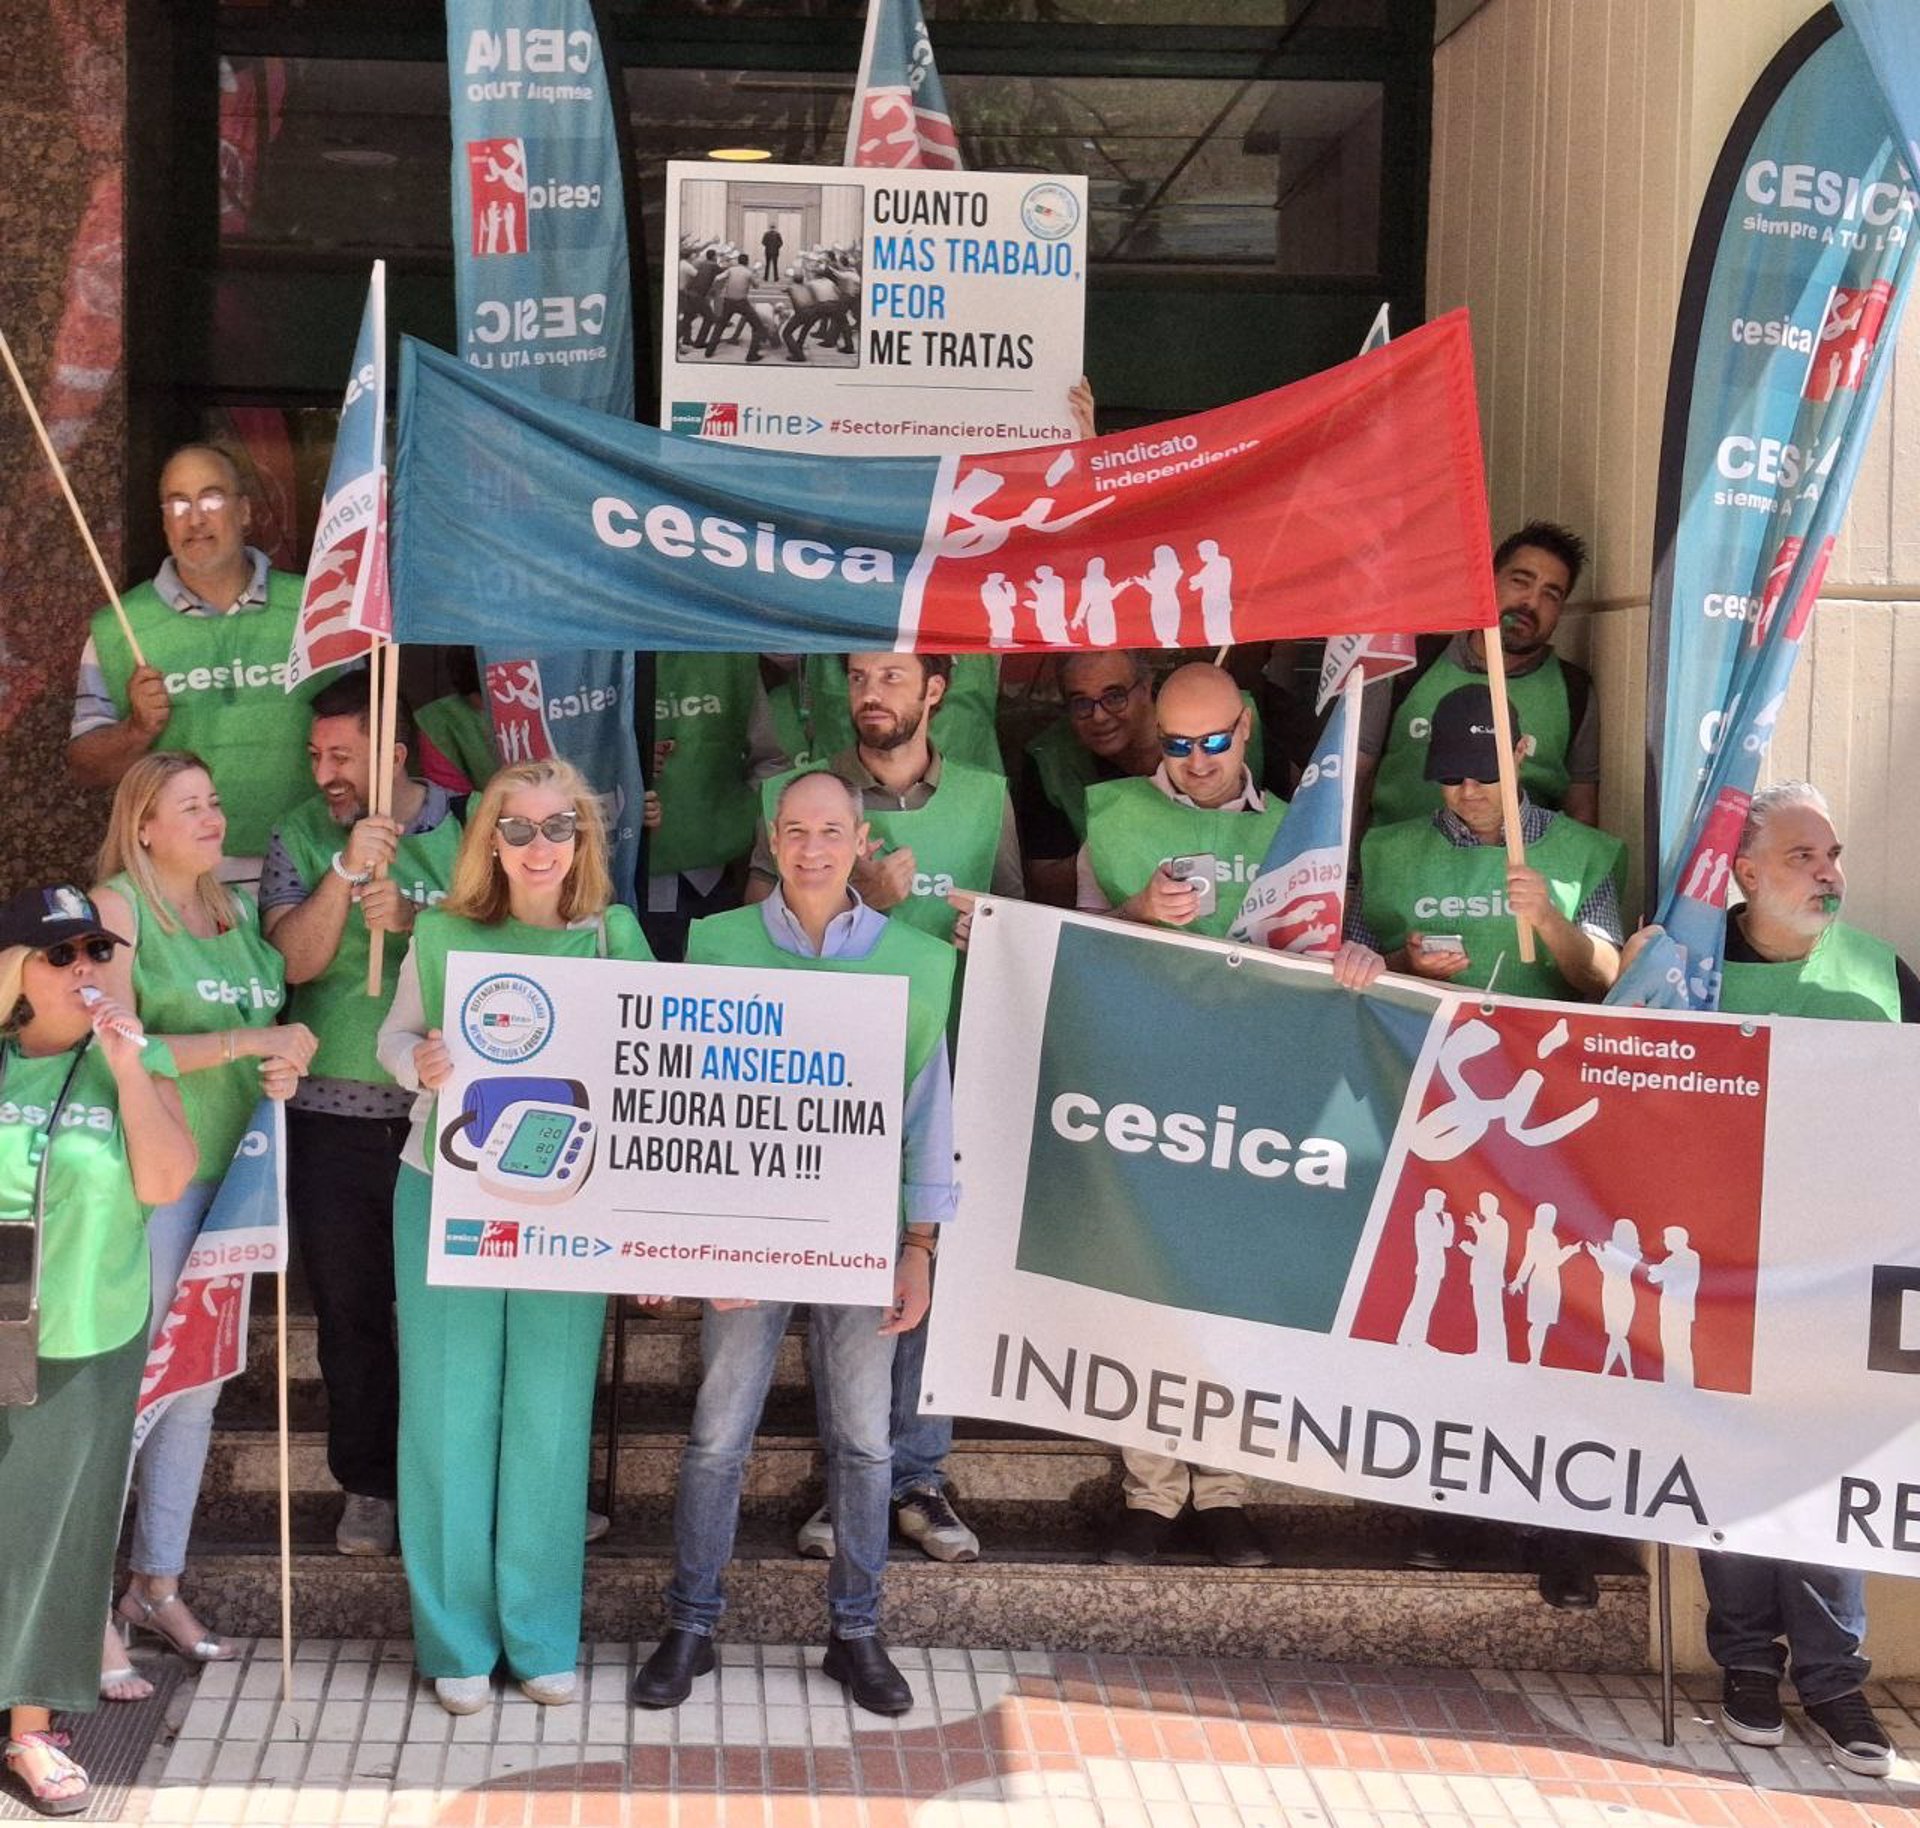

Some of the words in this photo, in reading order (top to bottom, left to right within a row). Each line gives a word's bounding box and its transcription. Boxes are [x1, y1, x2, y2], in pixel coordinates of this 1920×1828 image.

[874, 188, 988, 227] CUANTO
[873, 229, 935, 273] MÁS
[945, 238, 1080, 281] TRABAJO,
[871, 283, 945, 320] PEOR
[870, 330, 912, 366] ME
[922, 331, 1033, 369] TRATAS
[1732, 315, 1812, 354] cesica
[830, 418, 1072, 440] #SectorFinancieroEnLucha
[1091, 434, 1198, 471] sindicato
[1095, 439, 1259, 493] independiente
[591, 496, 895, 583] cesica
[164, 658, 289, 694] cesica
[617, 993, 653, 1029] TU
[661, 994, 784, 1037] PRESIÓN
[614, 1040, 650, 1076] ES
[658, 1043, 693, 1079] MI
[700, 1045, 853, 1088] ANSIEDAD.
[1583, 1033, 1696, 1060] sindicato
[1580, 1062, 1760, 1097] independiente
[612, 1087, 726, 1128] MEJORA
[735, 1094, 788, 1132] DEL
[797, 1097, 886, 1136] CLIMA
[609, 1134, 740, 1176] LABORAL
[749, 1141, 786, 1179] YA
[796, 1144, 822, 1180] !!!
[1050, 1091, 1348, 1189] cesica
[621, 1240, 887, 1270] #SectorFinancieroEnLucha
[991, 1333, 1710, 1527] INDEPENDENCIA
